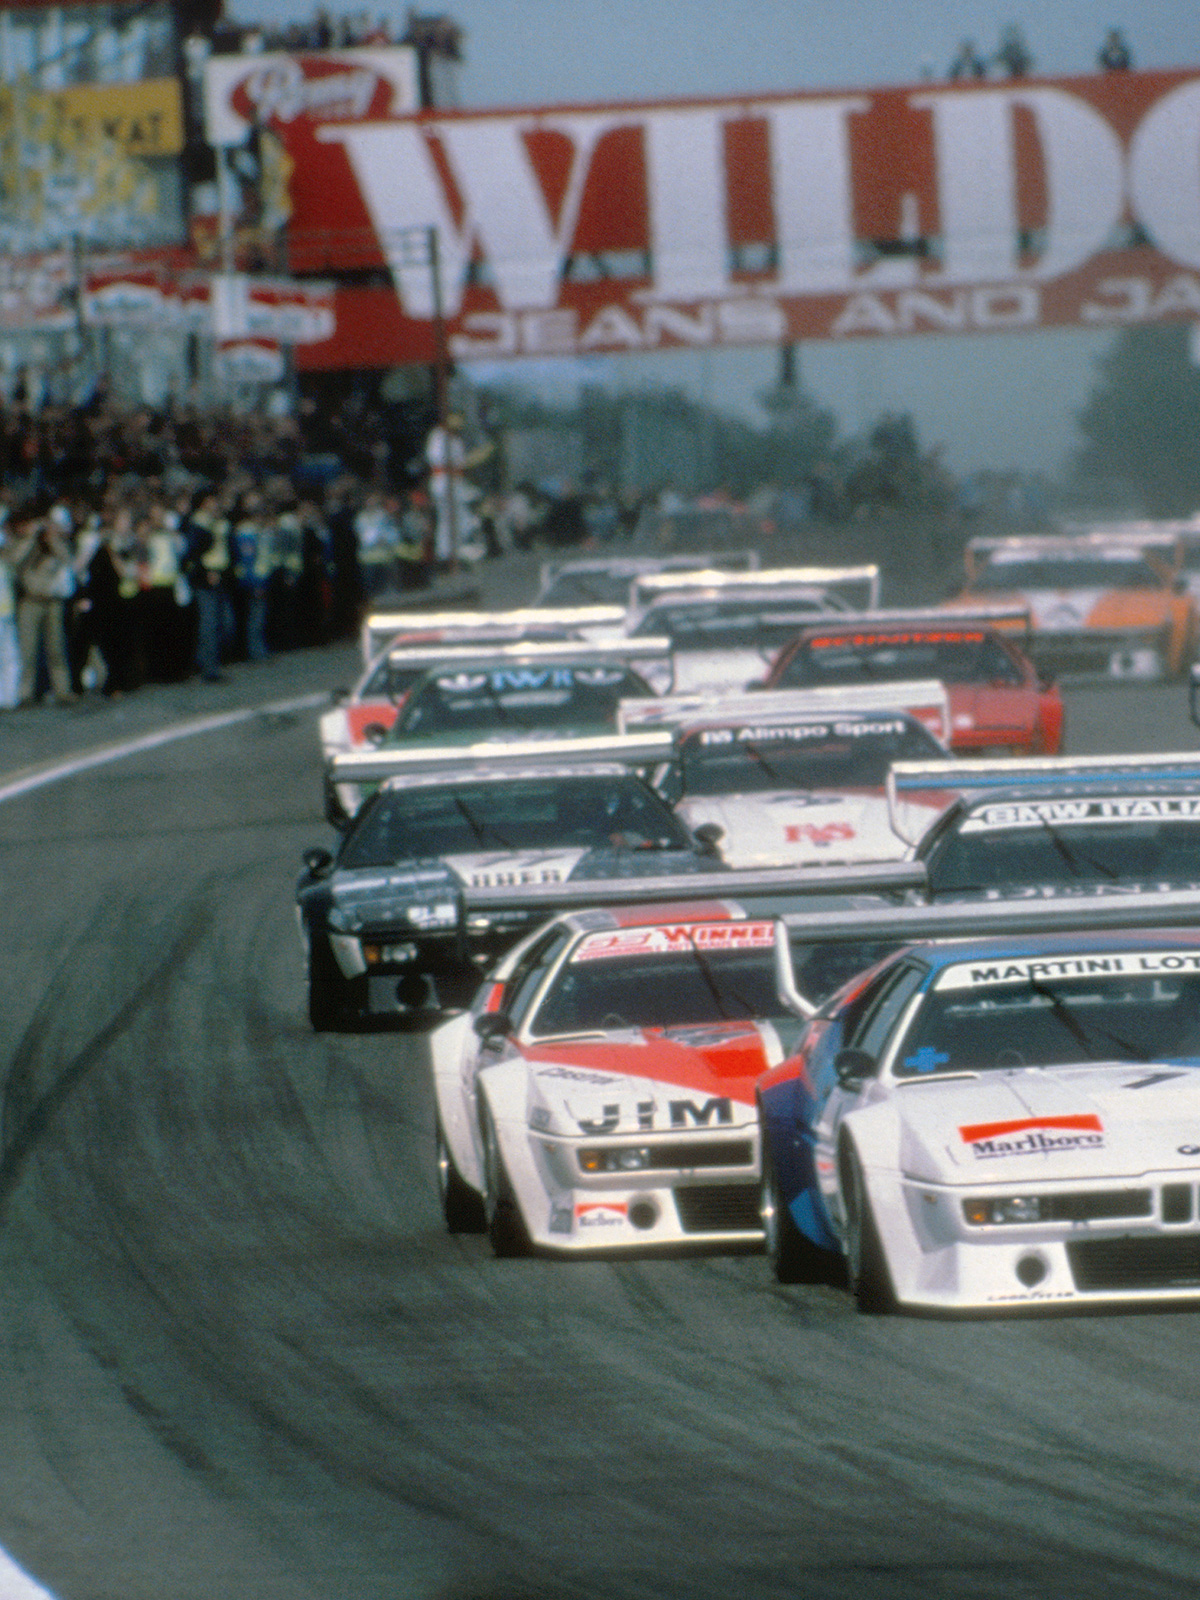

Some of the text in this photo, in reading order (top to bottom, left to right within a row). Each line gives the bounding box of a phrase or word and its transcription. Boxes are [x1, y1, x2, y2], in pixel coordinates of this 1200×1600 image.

[447, 302, 788, 356] JEANS
[831, 283, 1041, 336] AND
[738, 723, 828, 742] Alimpo
[833, 719, 906, 737] Sport
[985, 802, 1088, 825] BMW
[970, 957, 1123, 983] MARTINI
[973, 1133, 1104, 1155] Marlboro
